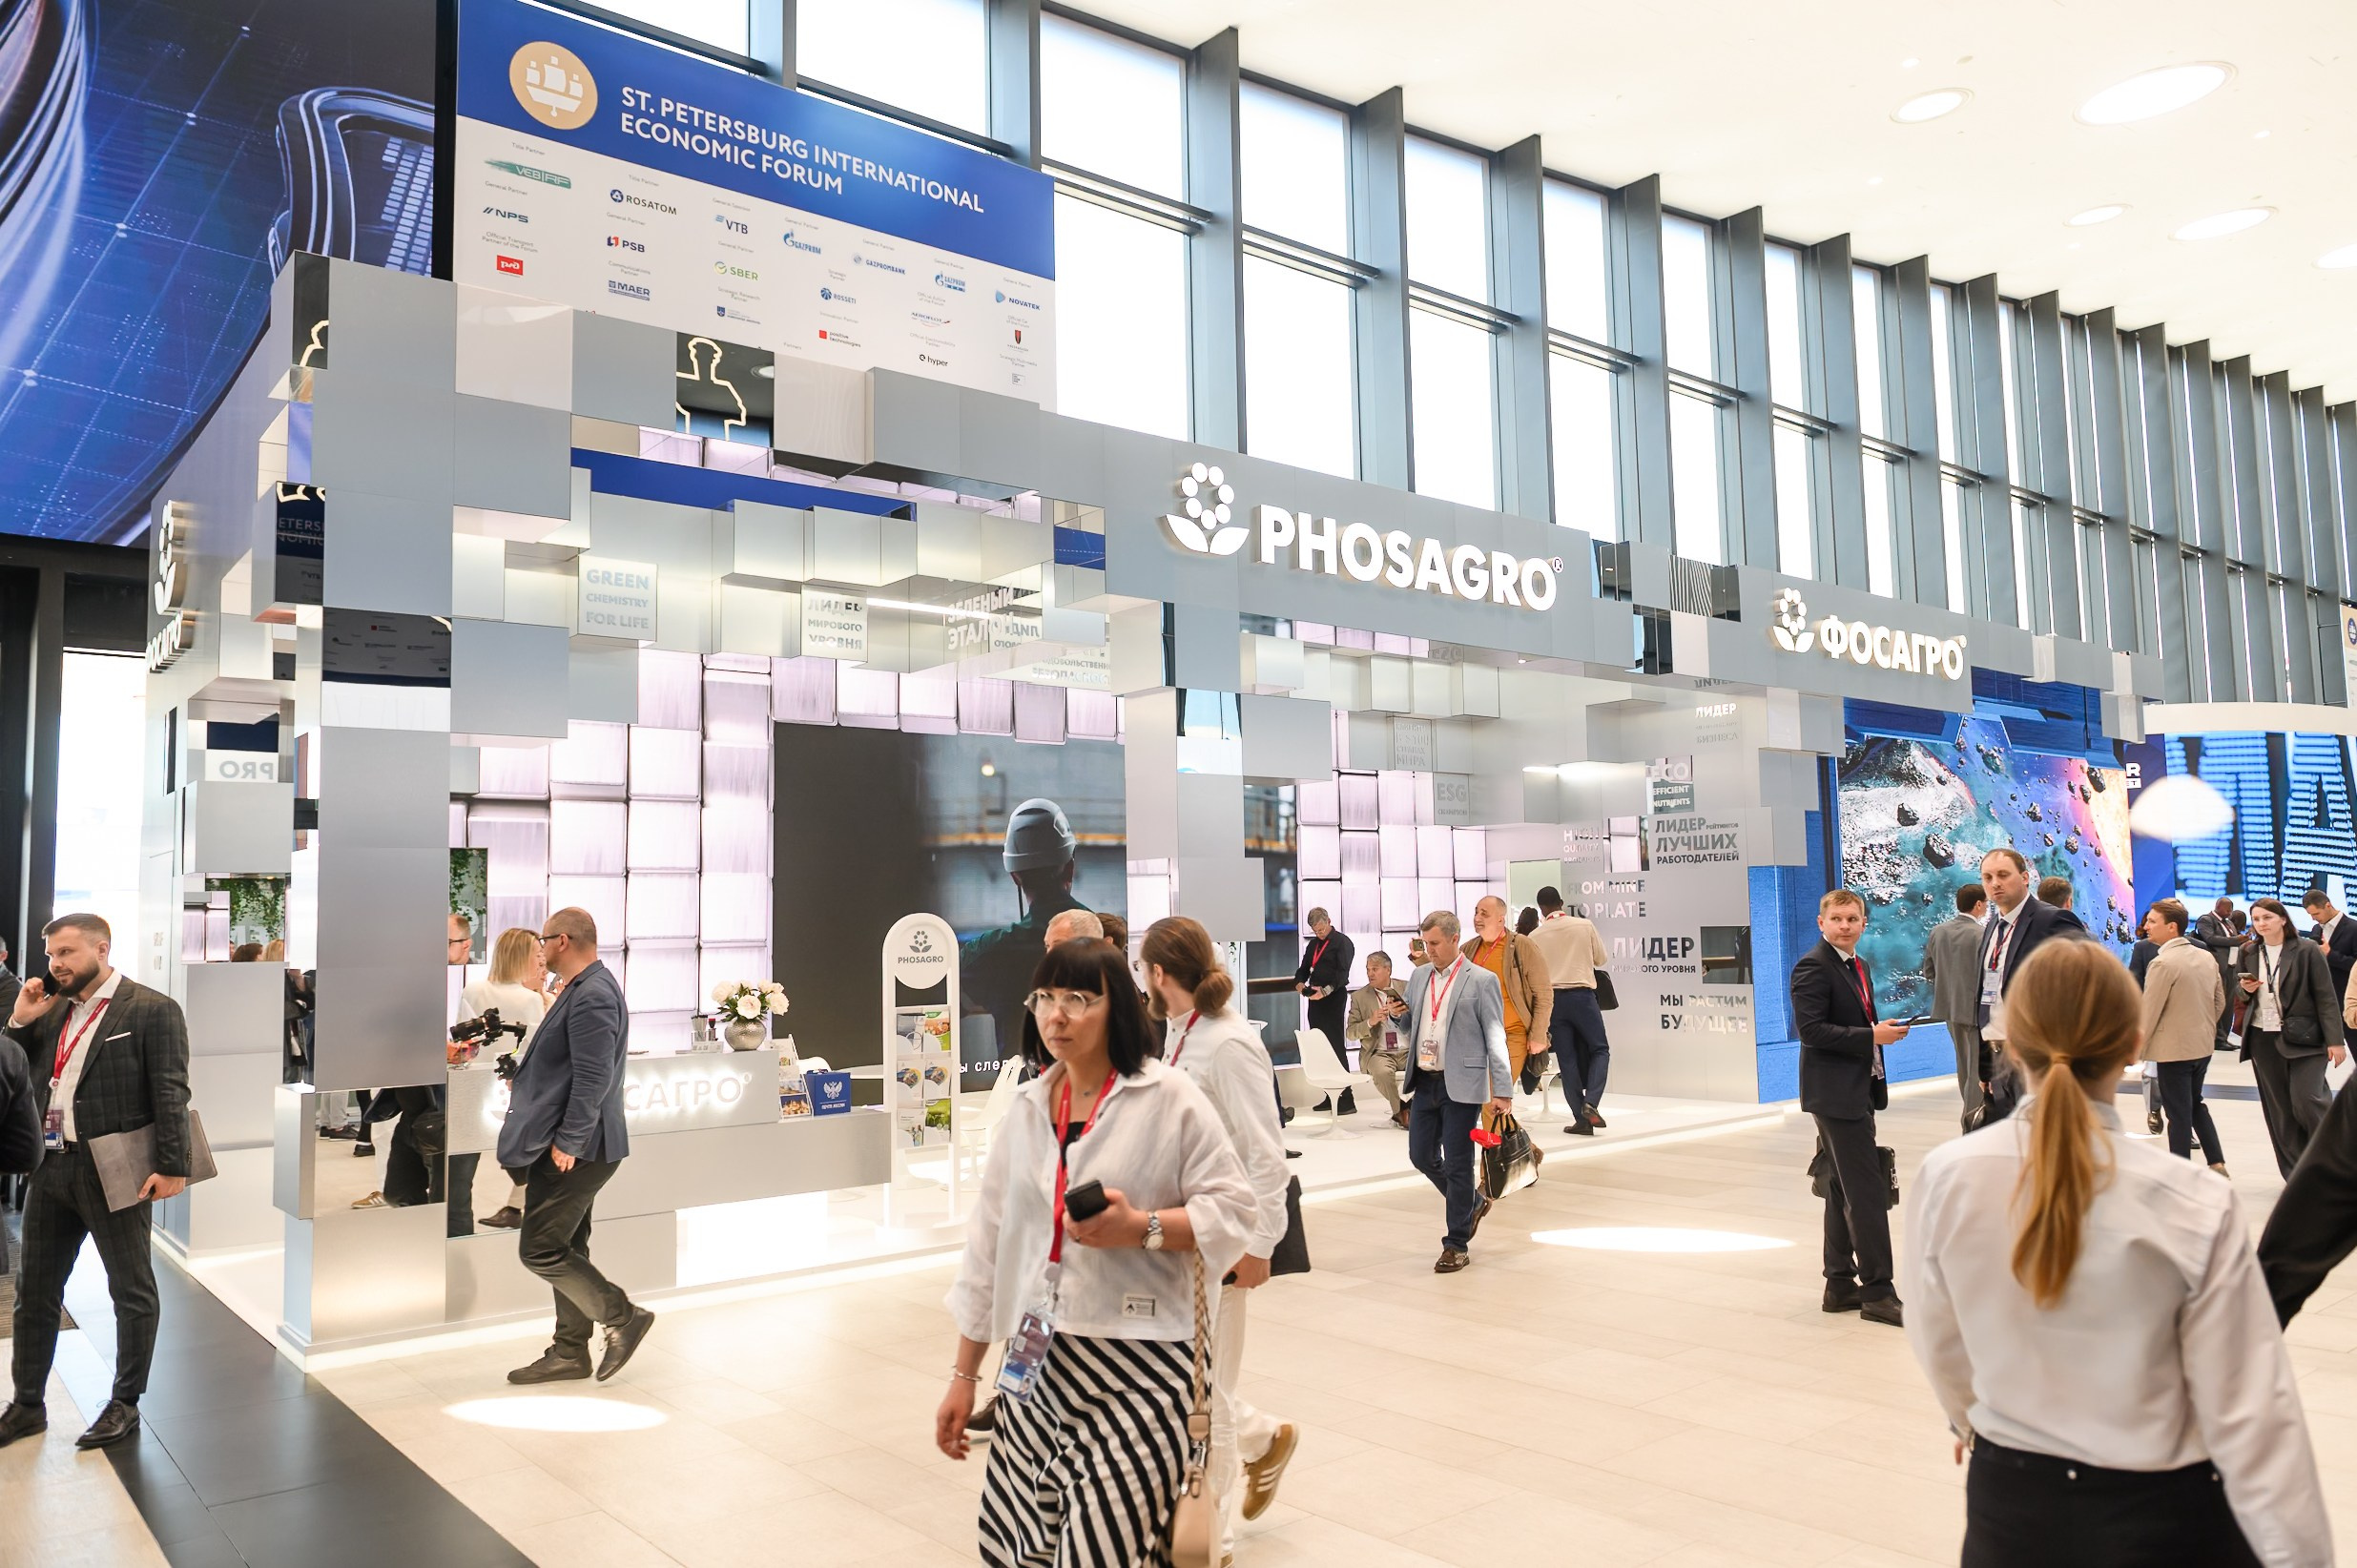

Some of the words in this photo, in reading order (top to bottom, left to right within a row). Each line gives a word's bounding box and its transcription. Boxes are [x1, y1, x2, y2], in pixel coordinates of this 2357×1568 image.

[621, 113, 755, 170] ECONOMIC
[762, 154, 843, 195] FORUM
[622, 86, 655, 113] ST.
[661, 97, 808, 159] PETERSBURG
[815, 145, 984, 213] INTERNATIONAL
[508, 186, 527, 196] Partner
[626, 195, 677, 216] ROSATOM
[496, 209, 528, 223] NPS
[726, 219, 748, 235] VTB
[622, 240, 645, 253] PSB
[730, 267, 758, 281] SBER
[866, 259, 906, 275] GAZPROMBANK
[618, 282, 650, 297] MAER
[834, 293, 857, 304] ROSSETI
[1009, 298, 1040, 311] NOVATEK
[927, 356, 948, 366] hyper
[279, 517, 324, 531] ETERS
[587, 569, 650, 589] GREEN
[586, 593, 649, 609] CHEMISTRY
[586, 610, 617, 627] FOR
[621, 615, 650, 629] LIFE
[808, 618, 862, 631] МИРОВОГО
[809, 633, 861, 650] УРОВНЯ
[1695, 703, 1737, 718] ЛИДЕР
[1437, 783, 1466, 801] ESG
[1652, 785, 1689, 795] EFFICIENT
[1652, 797, 1690, 809] NUTRIENTS
[1656, 817, 1706, 834] ЛИДЕР
[1656, 833, 1737, 853] ЛУЧШИХ
[1657, 851, 1739, 864] РАБОТОДАТЕЛЕЙ
[1567, 903, 1590, 918] TO
[1595, 901, 1646, 918] PLATE
[1613, 937, 1695, 961] ЛИДЕР
[898, 956, 944, 964] PHOSAGRO
[1612, 964, 1659, 973] МИРОВОГО
[1662, 964, 1696, 974] УРОВНЯ
[1661, 995, 1683, 1006] МЫ
[1688, 995, 1747, 1007] РАСТИМ
[1662, 1015, 1747, 1034] БУДУЩЕЕ
[625, 1077, 741, 1111] САГРО
